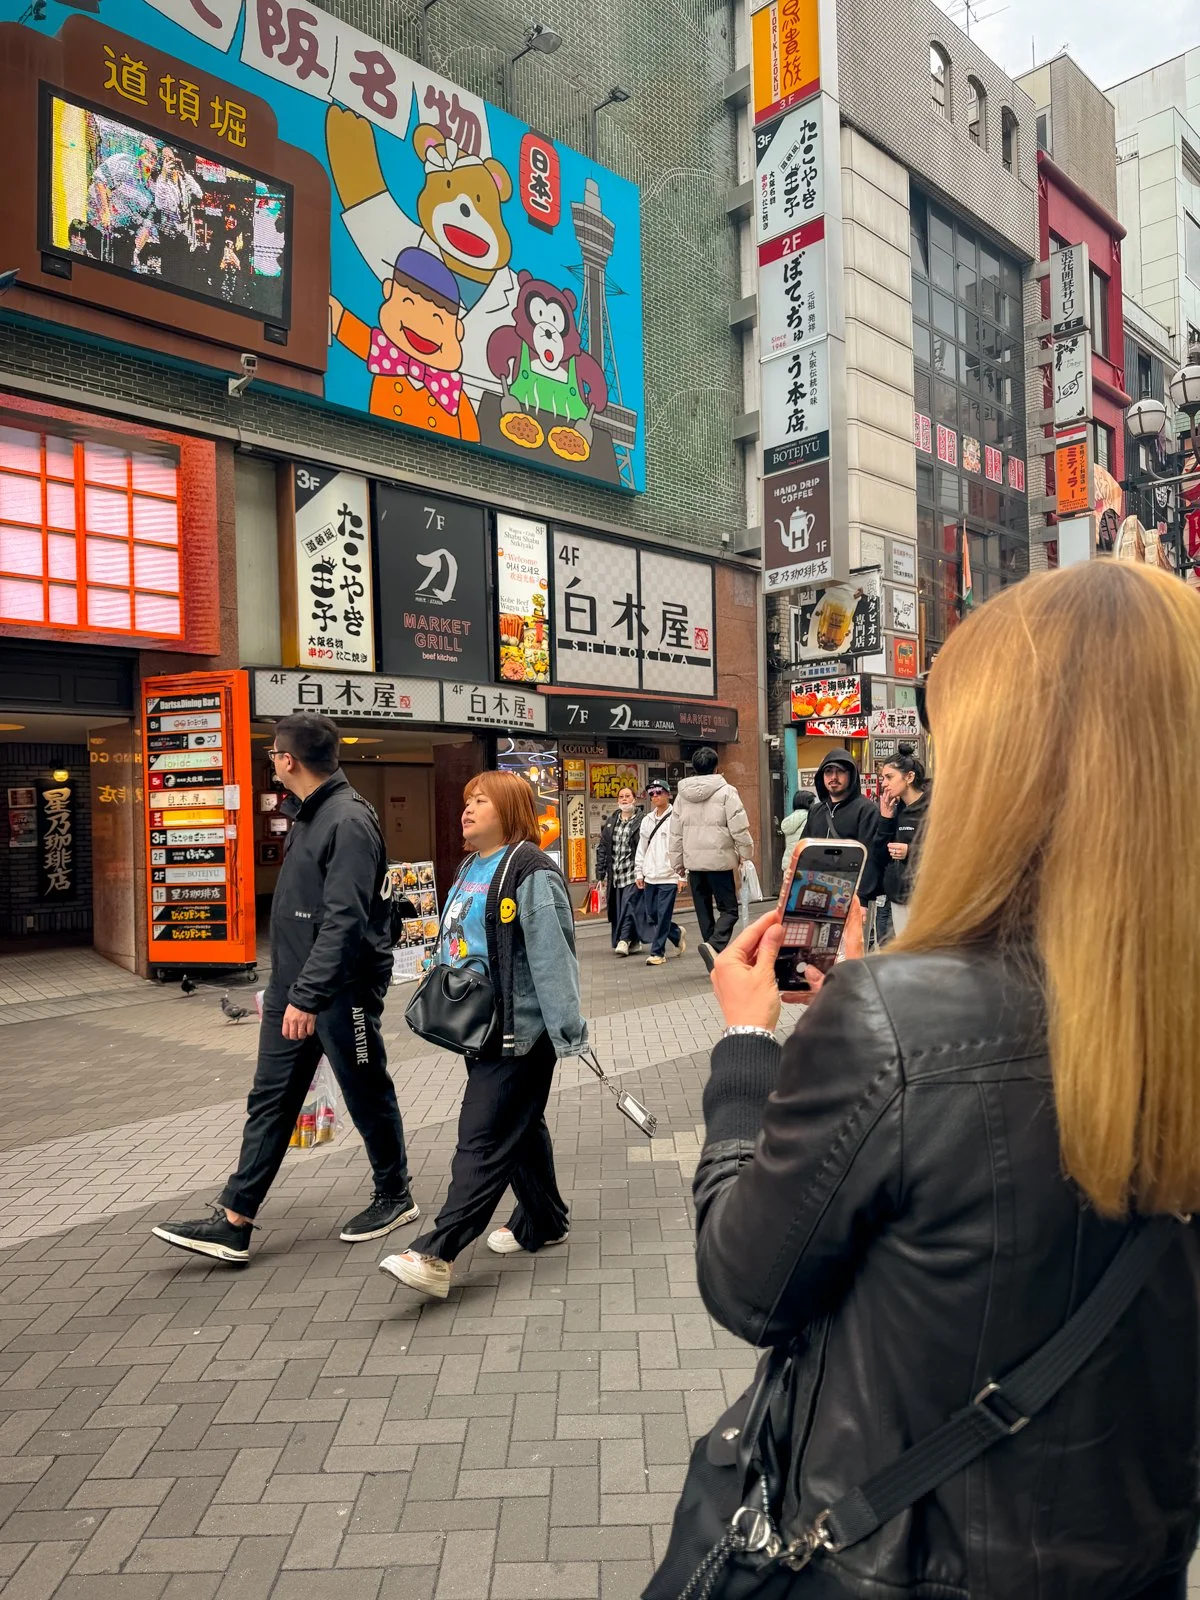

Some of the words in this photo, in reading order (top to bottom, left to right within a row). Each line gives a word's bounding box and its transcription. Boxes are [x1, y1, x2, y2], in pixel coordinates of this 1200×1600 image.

[771, 8, 779, 91] TORIKIZOKU
[188, 0, 483, 157] 阪名物
[103, 45, 248, 148] 道頓堀
[779, 94, 795, 110] 3F
[757, 134, 772, 149] 3F
[800, 119, 818, 209] たこやき
[527, 147, 553, 212] 日本一
[782, 232, 801, 255] 2F
[771, 333, 787, 345] Since
[772, 340, 787, 351] 1946
[808, 350, 818, 406] 大阪伝統の味
[773, 439, 820, 465] BOTEJYU
[296, 469, 320, 491] 3F
[1067, 447, 1077, 499] ミティラー
[774, 483, 798, 497] HAND
[799, 477, 821, 491] DRIP
[780, 488, 814, 504] COFFEE
[423, 507, 445, 531] 7F
[558, 545, 580, 567] 4F
[816, 540, 828, 553] 1F
[337, 503, 365, 636] たこやき
[768, 560, 828, 588] 星乃珈琲店
[565, 576, 692, 650] 白木屋
[403, 612, 471, 635] MARKET
[308, 636, 344, 649] 大阪名物
[414, 632, 463, 652] GRILL
[308, 648, 334, 659] 串かつ
[336, 651, 368, 663] たこ焼き
[422, 651, 436, 662] beef
[436, 653, 458, 662] kitchen
[270, 673, 287, 685] 4F
[298, 674, 398, 709] 白木屋
[452, 685, 463, 695] 4F
[470, 687, 527, 719] 白木屋
[567, 705, 589, 724] 7F
[679, 713, 713, 726] MARKET
[568, 761, 581, 770] 3F
[42, 786, 73, 896] 星乃珈琲店
[152, 832, 167, 844] 3F
[153, 852, 164, 861] 2F
[154, 871, 165, 881] 2F
[187, 869, 220, 878] BOTEJYU
[155, 889, 164, 900] 1F
[171, 888, 221, 900] 星乃珈琲店
[352, 1006, 369, 1065] ADVENTURE
